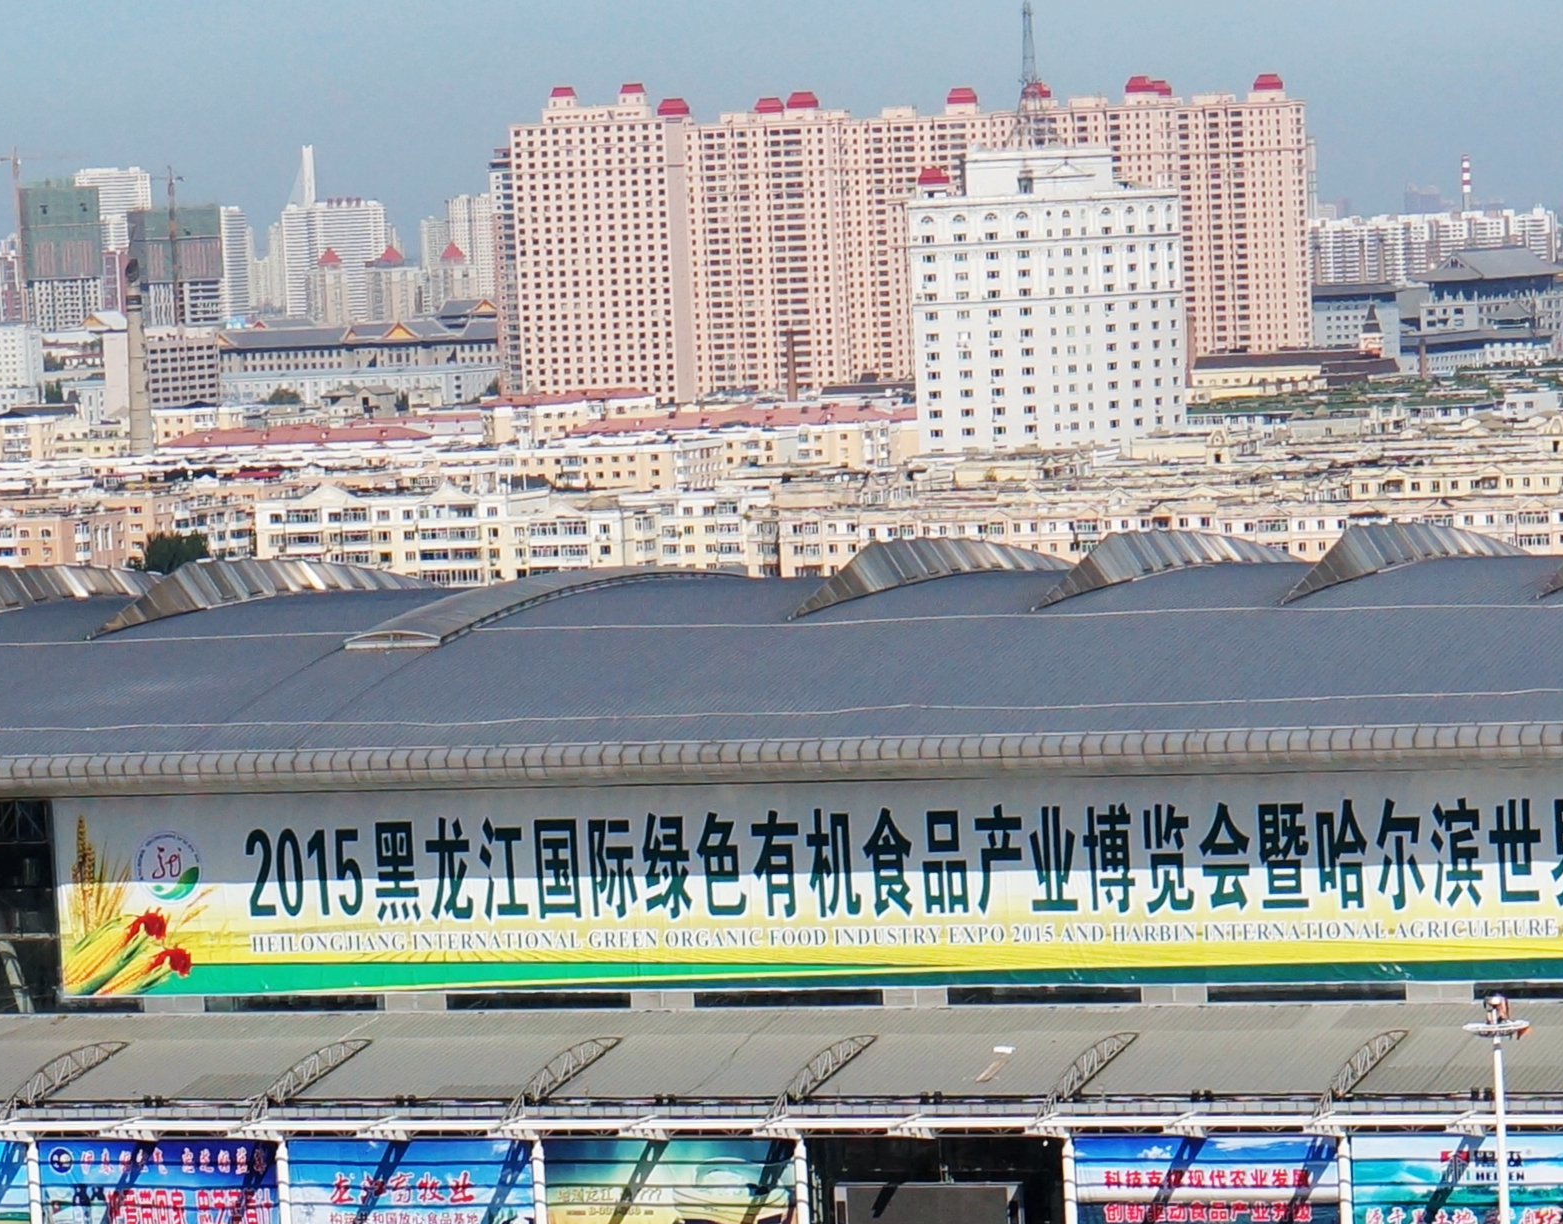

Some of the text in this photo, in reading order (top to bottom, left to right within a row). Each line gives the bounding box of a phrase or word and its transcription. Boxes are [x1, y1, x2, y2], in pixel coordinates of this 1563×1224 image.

[251, 933, 405, 952] HEILONGJIANG
[412, 931, 581, 950] INTERNATIONAL
[588, 930, 657, 949] GREEN
[664, 928, 763, 947] ORGANIC
[768, 928, 827, 946] FOOD
[834, 926, 940, 945] INDUSTRY
[947, 926, 1005, 944] EXPO
[1012, 925, 1052, 943] 2015
[1059, 925, 1105, 943] AND
[1112, 923, 1197, 942] HARBIN
[1204, 921, 1388, 941] INTERNATIONAL
[1394, 919, 1557, 939] AGRICULTURE
[1104, 1169, 1311, 1189] 科技支撑现代农业发展
[1476, 1171, 1525, 1181] HEIEN
[1104, 1201, 1313, 1222] 创新驱动食品产业升级
